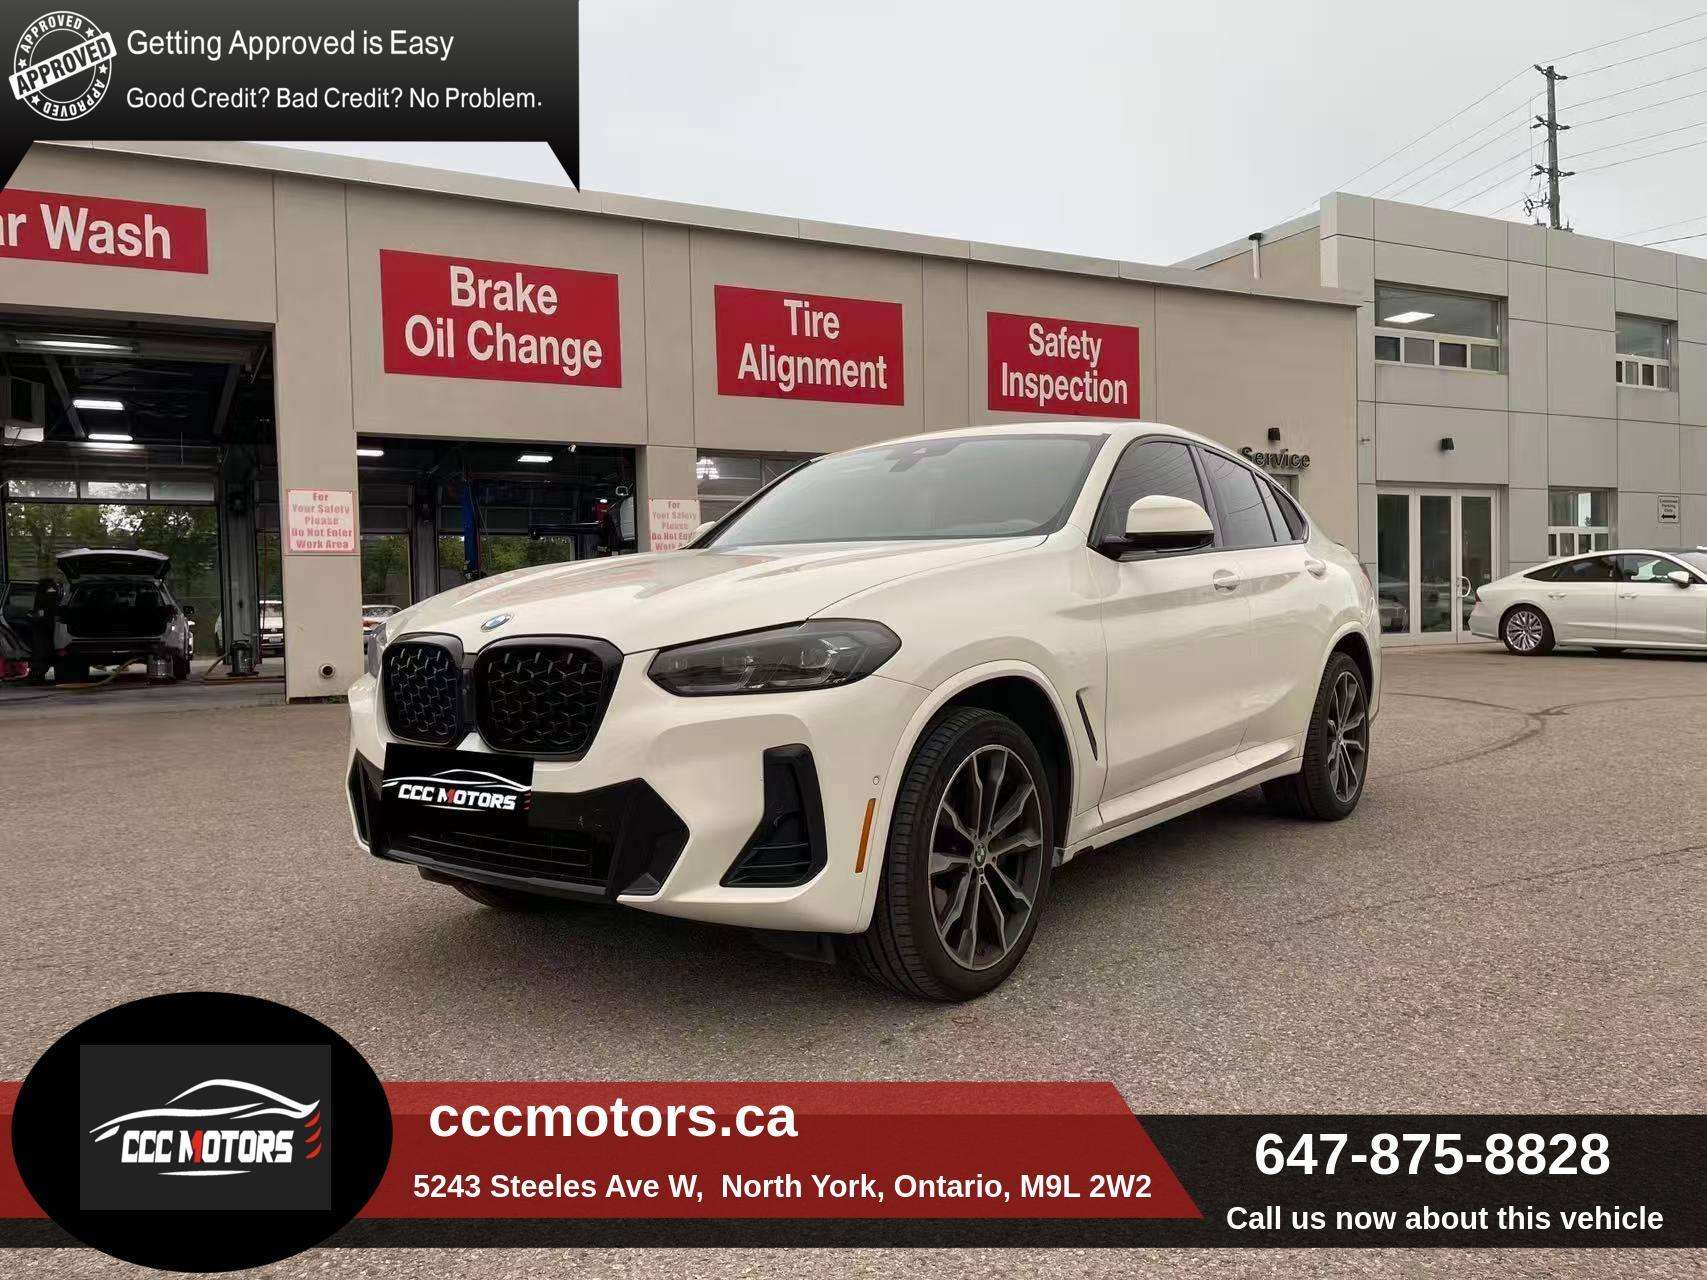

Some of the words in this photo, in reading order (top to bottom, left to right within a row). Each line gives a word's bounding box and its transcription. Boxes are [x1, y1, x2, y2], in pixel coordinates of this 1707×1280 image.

[40, 203, 171, 260] Wash
[450, 264, 559, 316] Brake
[783, 299, 840, 340] Tire
[405, 314, 455, 358] Oil
[467, 319, 603, 377] Change
[1028, 322, 1103, 369] Safety
[737, 342, 888, 393] Alignment
[1001, 362, 1128, 407] Inspection
[1240, 446, 1311, 469] Service
[292, 503, 316, 513] Your
[318, 503, 350, 513] Safety
[312, 492, 329, 501] For
[291, 528, 305, 537] Do
[307, 528, 325, 537] Not
[326, 528, 353, 538] Enter
[304, 515, 339, 525] Please
[296, 539, 323, 549] Work
[325, 540, 349, 549] Area
